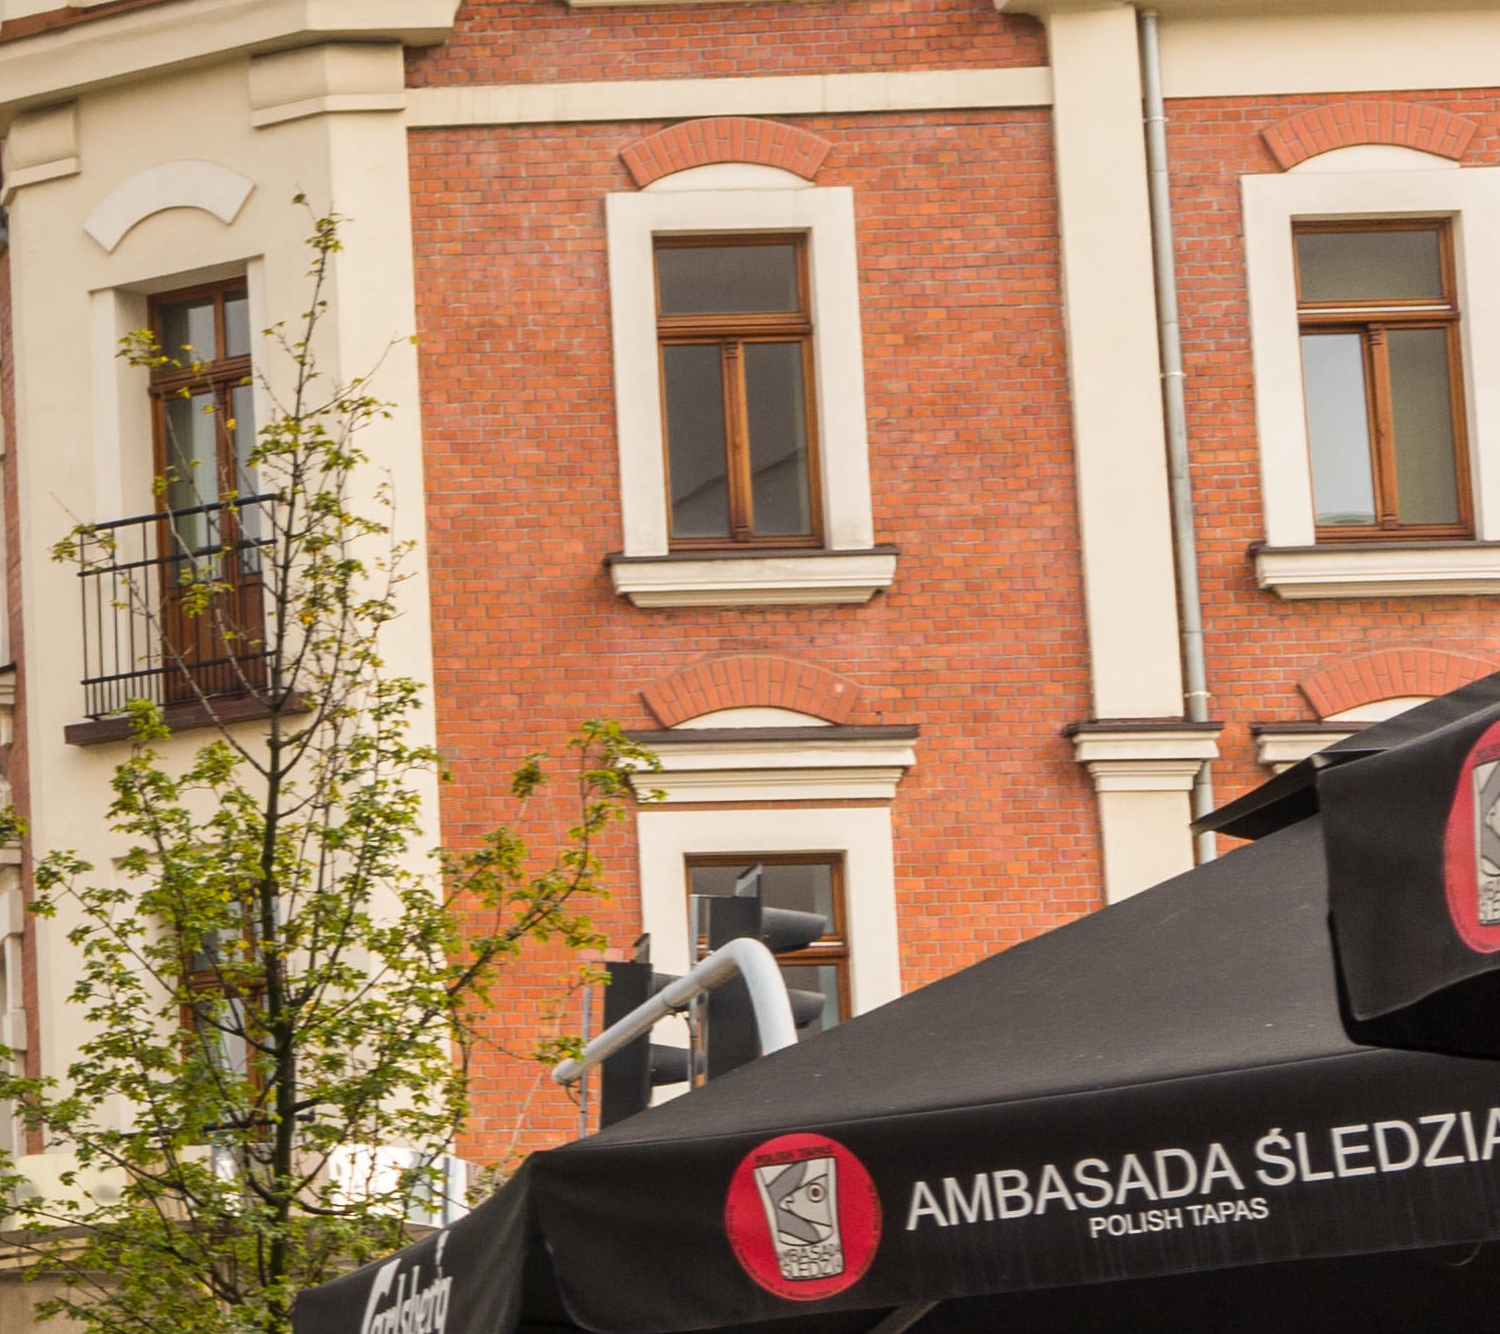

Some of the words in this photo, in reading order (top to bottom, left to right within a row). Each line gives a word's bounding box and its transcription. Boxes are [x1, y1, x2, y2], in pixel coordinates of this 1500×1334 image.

[905, 1142, 1244, 1231] AMBASADA
[1088, 1213, 1183, 1239] POLISH
[1185, 1198, 1269, 1227] TAPAS
